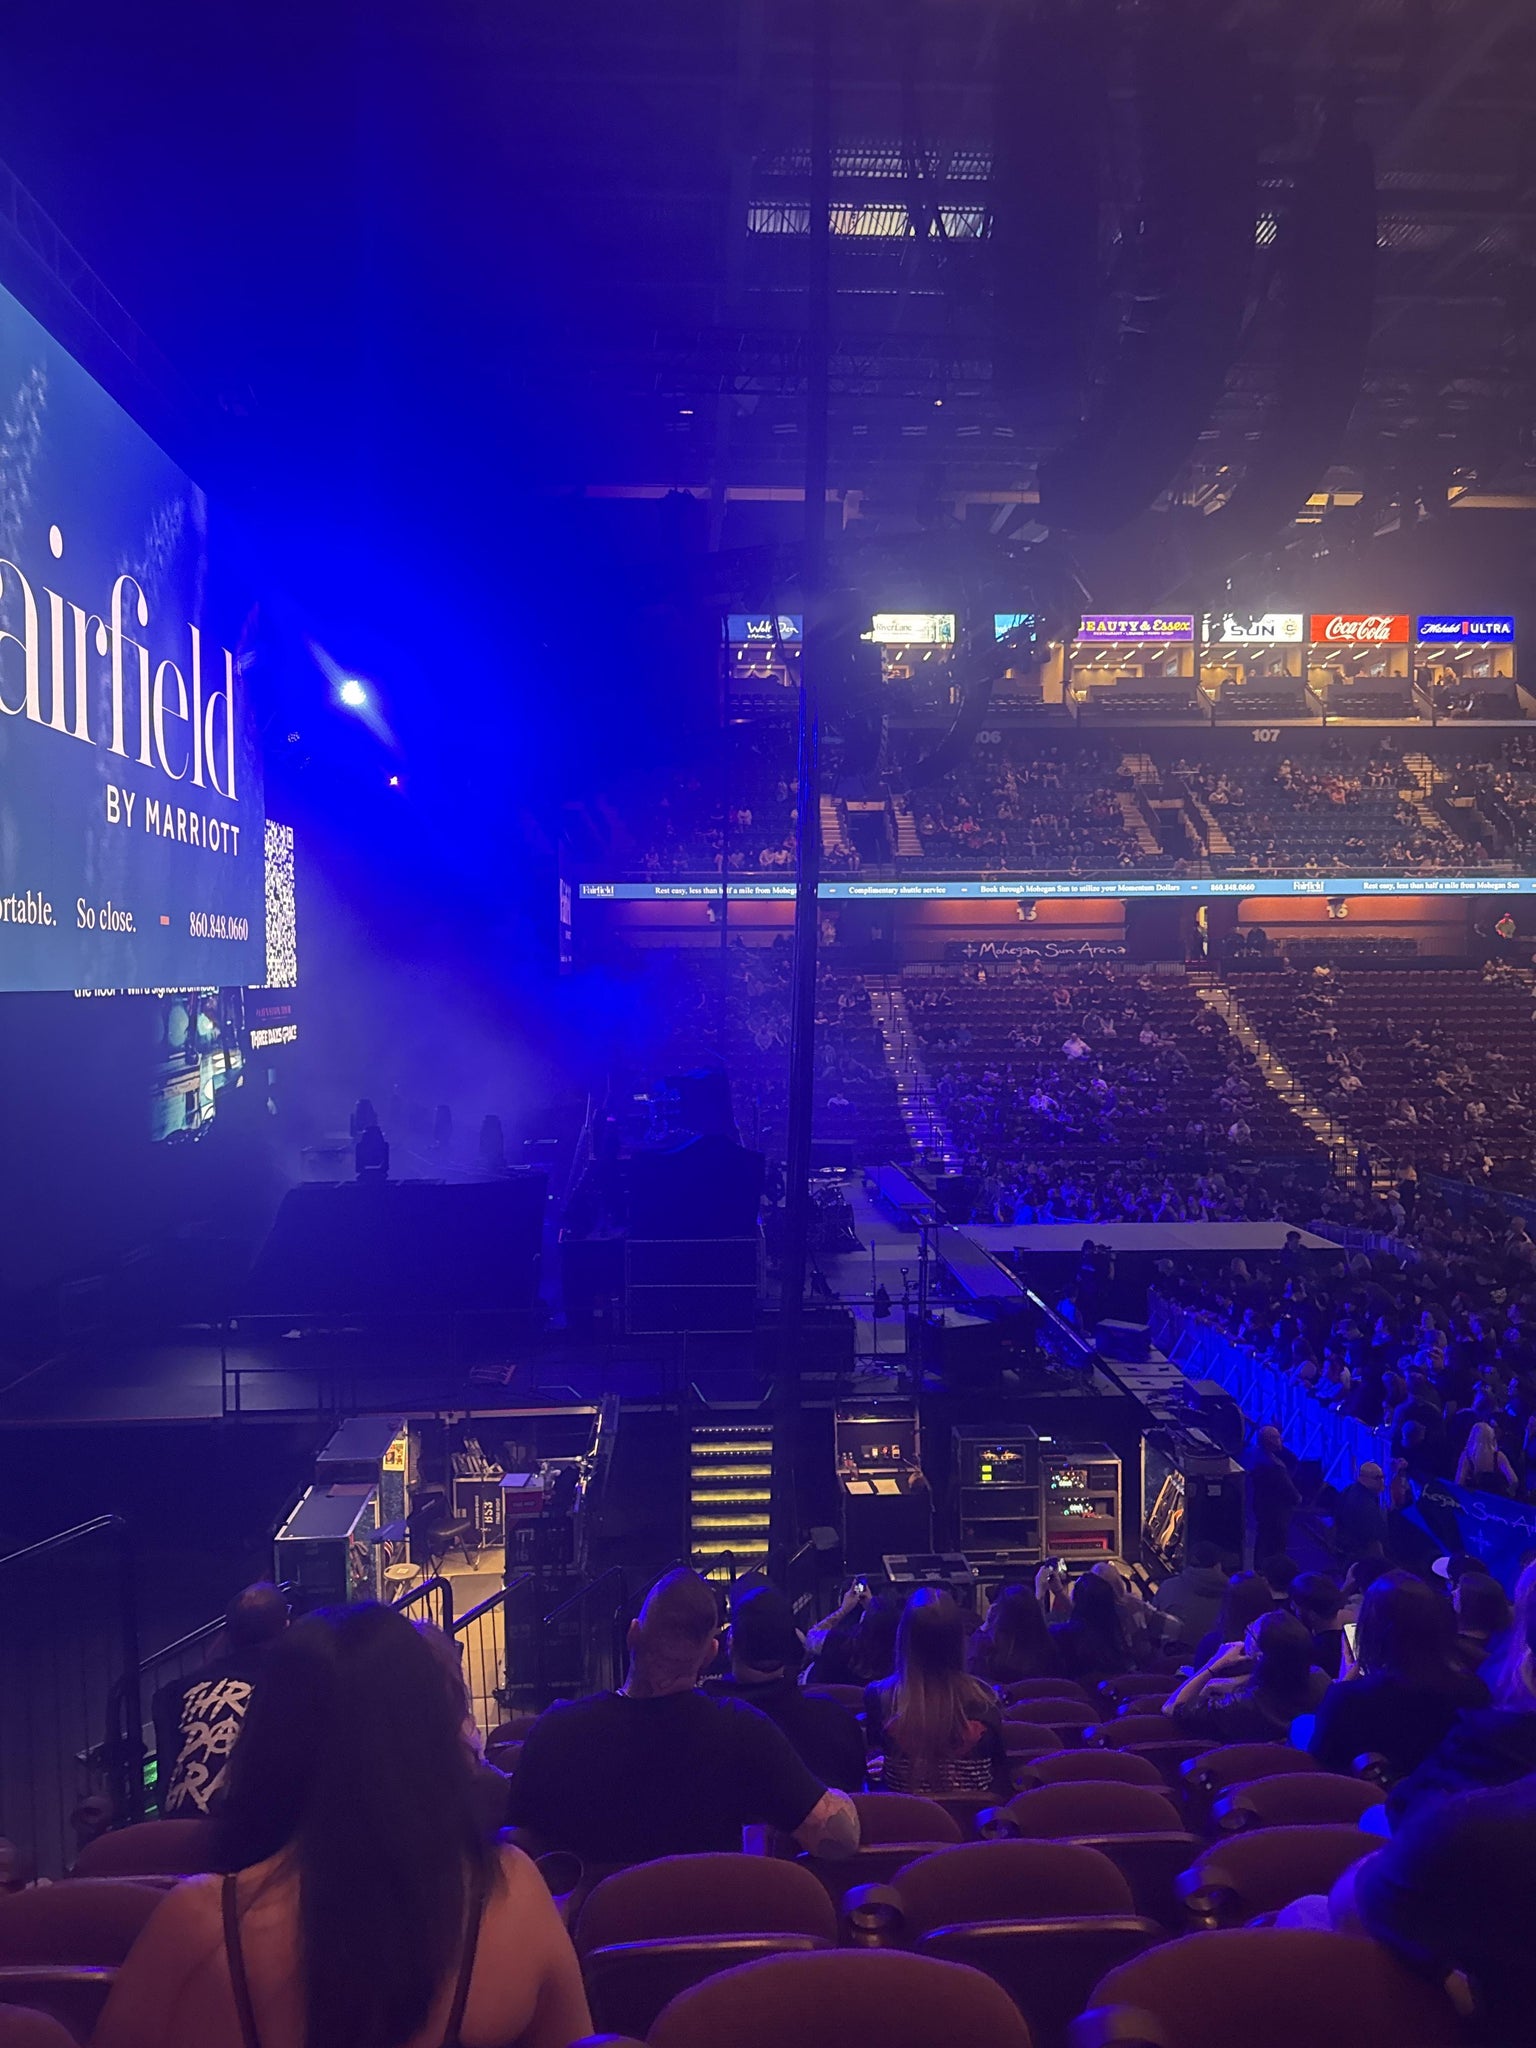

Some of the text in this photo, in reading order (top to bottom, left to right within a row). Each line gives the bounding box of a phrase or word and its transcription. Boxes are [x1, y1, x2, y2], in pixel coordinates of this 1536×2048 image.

[1140, 621, 1152, 631] &
[1152, 619, 1190, 631] Essex
[1325, 616, 1396, 640] Coca-Cola
[1420, 623, 1511, 634] Michelob ULTRA
[1231, 626, 1274, 636] SUN
[1252, 729, 1280, 742] 107
[107, 784, 240, 856] BY MARRIOTT
[583, 885, 615, 896] Fairfield
[655, 886, 670, 894] Rest
[671, 887, 688, 896] easy,
[719, 886, 733, 894] hlf
[739, 886, 754, 894] mile
[755, 886, 771, 894] from
[772, 886, 797, 896] Moheg
[848, 886, 946, 895] Complimentary shuttle service
[980, 885, 998, 893] Book
[999, 885, 1025, 895] through
[1026, 885, 1056, 895] Mohegan
[1080, 884, 1100, 892] utilize
[1101, 886, 1117, 894] your
[1118, 884, 1155, 892] Momentum
[1156, 884, 1180, 892] Dollars
[1210, 883, 1256, 891] 860.848.0660
[1293, 881, 1324, 890] Fairfield
[1379, 882, 1395, 890] easy,
[1396, 881, 1409, 889] less
[1410, 881, 1424, 889] than
[1425, 881, 1438, 889] half
[1444, 881, 1459, 889] mile
[1460, 881, 1475, 889] from
[1477, 881, 1506, 890] Mohegan
[1507, 881, 1520, 889] Sun
[1326, 904, 1348, 918] 16
[76, 898, 96, 930] So
[100, 901, 137, 933] close.
[189, 911, 249, 941] 860.848.0660
[979, 942, 1127, 958] Mohegan Sun Arena
